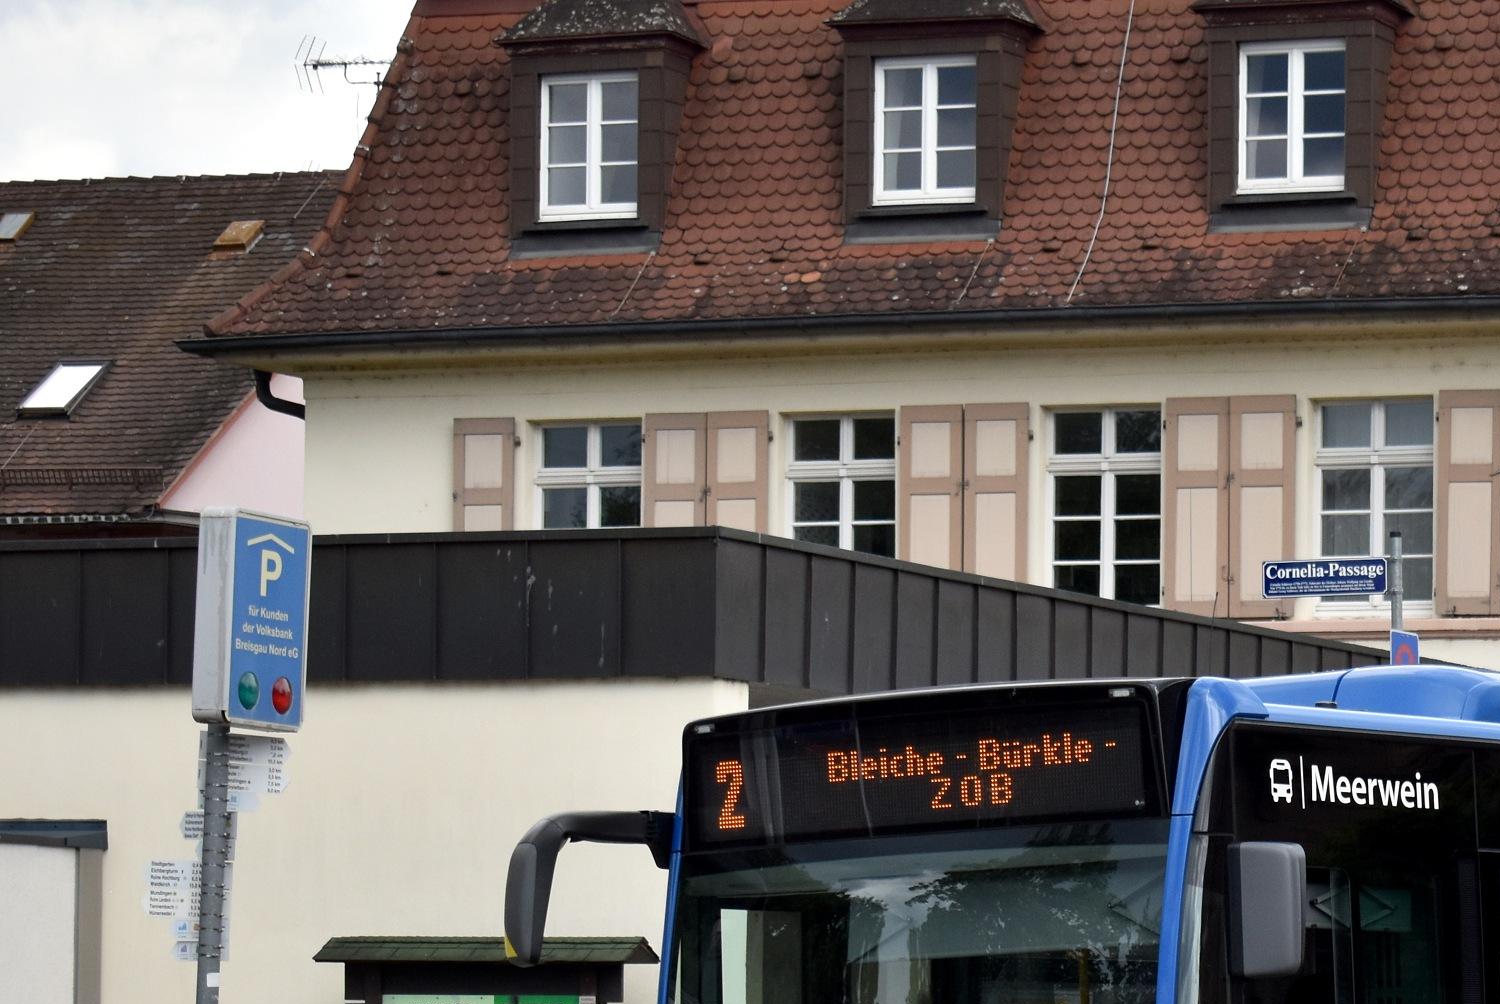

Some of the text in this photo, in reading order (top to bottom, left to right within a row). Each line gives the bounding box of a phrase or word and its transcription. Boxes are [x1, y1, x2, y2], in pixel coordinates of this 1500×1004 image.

[260, 549, 282, 597] P
[1266, 563, 1384, 579] Cornelia-Passage
[248, 605, 288, 621] für Kunden
[242, 622, 293, 639] der Volksbank
[235, 638, 298, 658] Breisgau Nord eG
[827, 746, 944, 783] Bleiche
[978, 732, 1093, 771] Bürkle
[716, 760, 745, 830] 2
[1311, 764, 1440, 810] Meerwein
